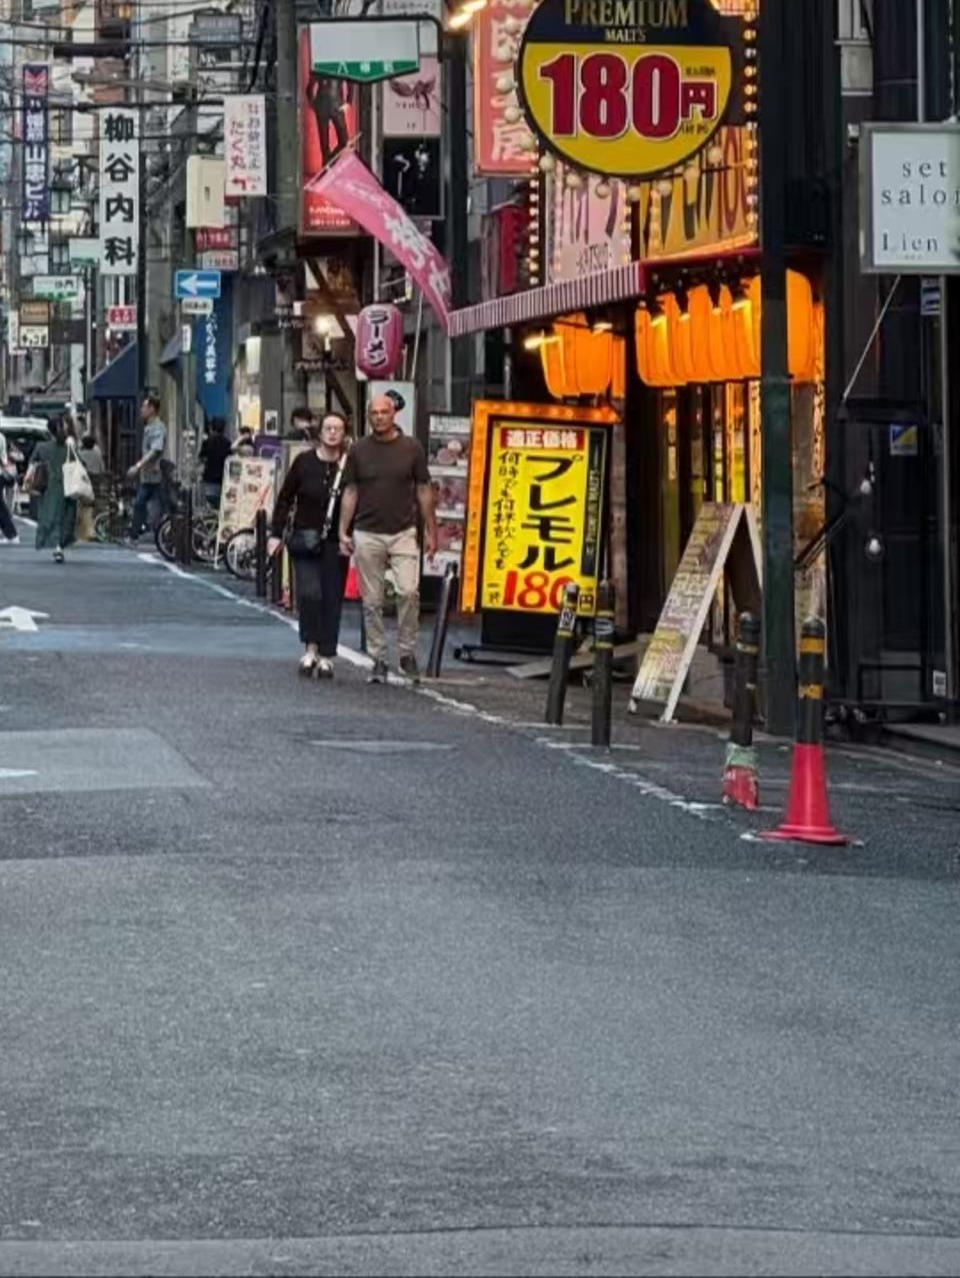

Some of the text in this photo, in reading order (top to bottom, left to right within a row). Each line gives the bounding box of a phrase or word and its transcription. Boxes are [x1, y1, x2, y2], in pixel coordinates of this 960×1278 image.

[540, 52, 718, 139] 180円
[902, 160, 948, 179] set
[104, 113, 136, 267] 柳谷内科
[880, 184, 960, 205] salo
[881, 232, 939, 252] Lien
[365, 309, 390, 367] ラーメン
[506, 429, 578, 448] 適正価格
[516, 453, 584, 571] プレモル
